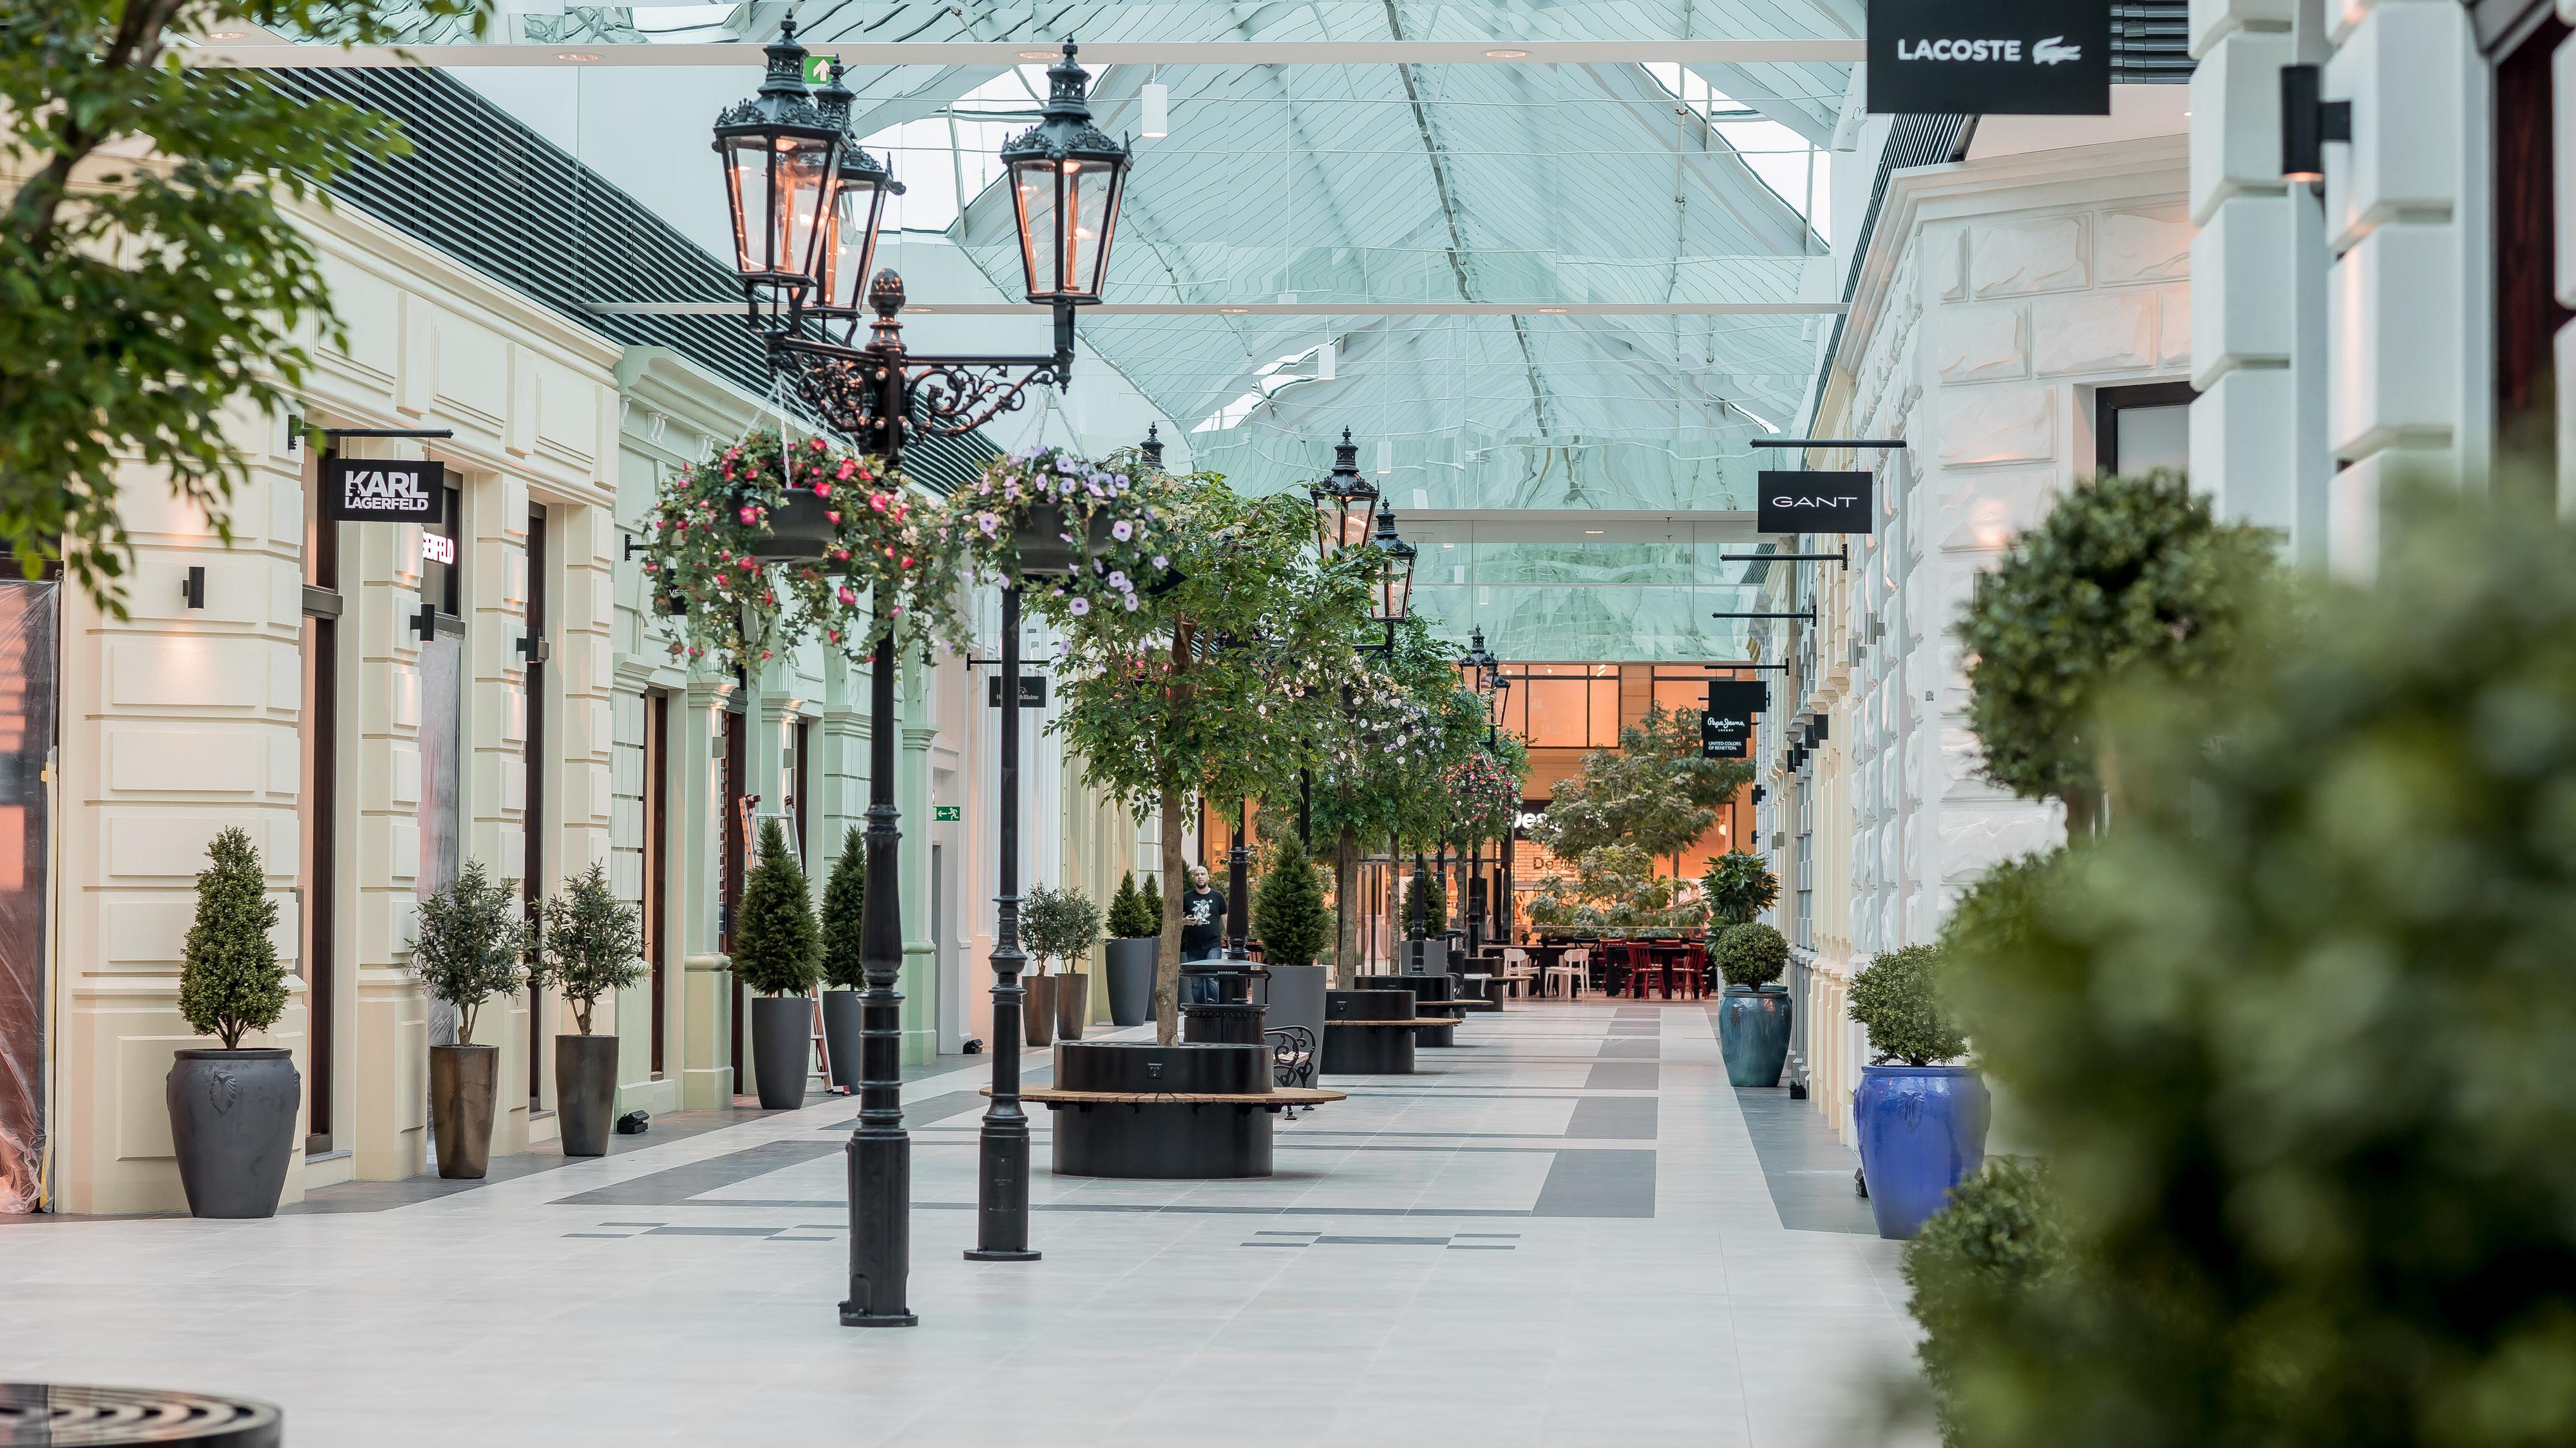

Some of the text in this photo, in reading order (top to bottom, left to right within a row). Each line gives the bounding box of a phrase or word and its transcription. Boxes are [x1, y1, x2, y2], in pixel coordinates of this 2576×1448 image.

[1897, 39, 2022, 62] LACOSTE
[345, 471, 429, 498] KARL
[345, 496, 429, 511] LAGERFELD
[1772, 496, 1858, 507] GANT
[1707, 717, 1723, 728] Pepe
